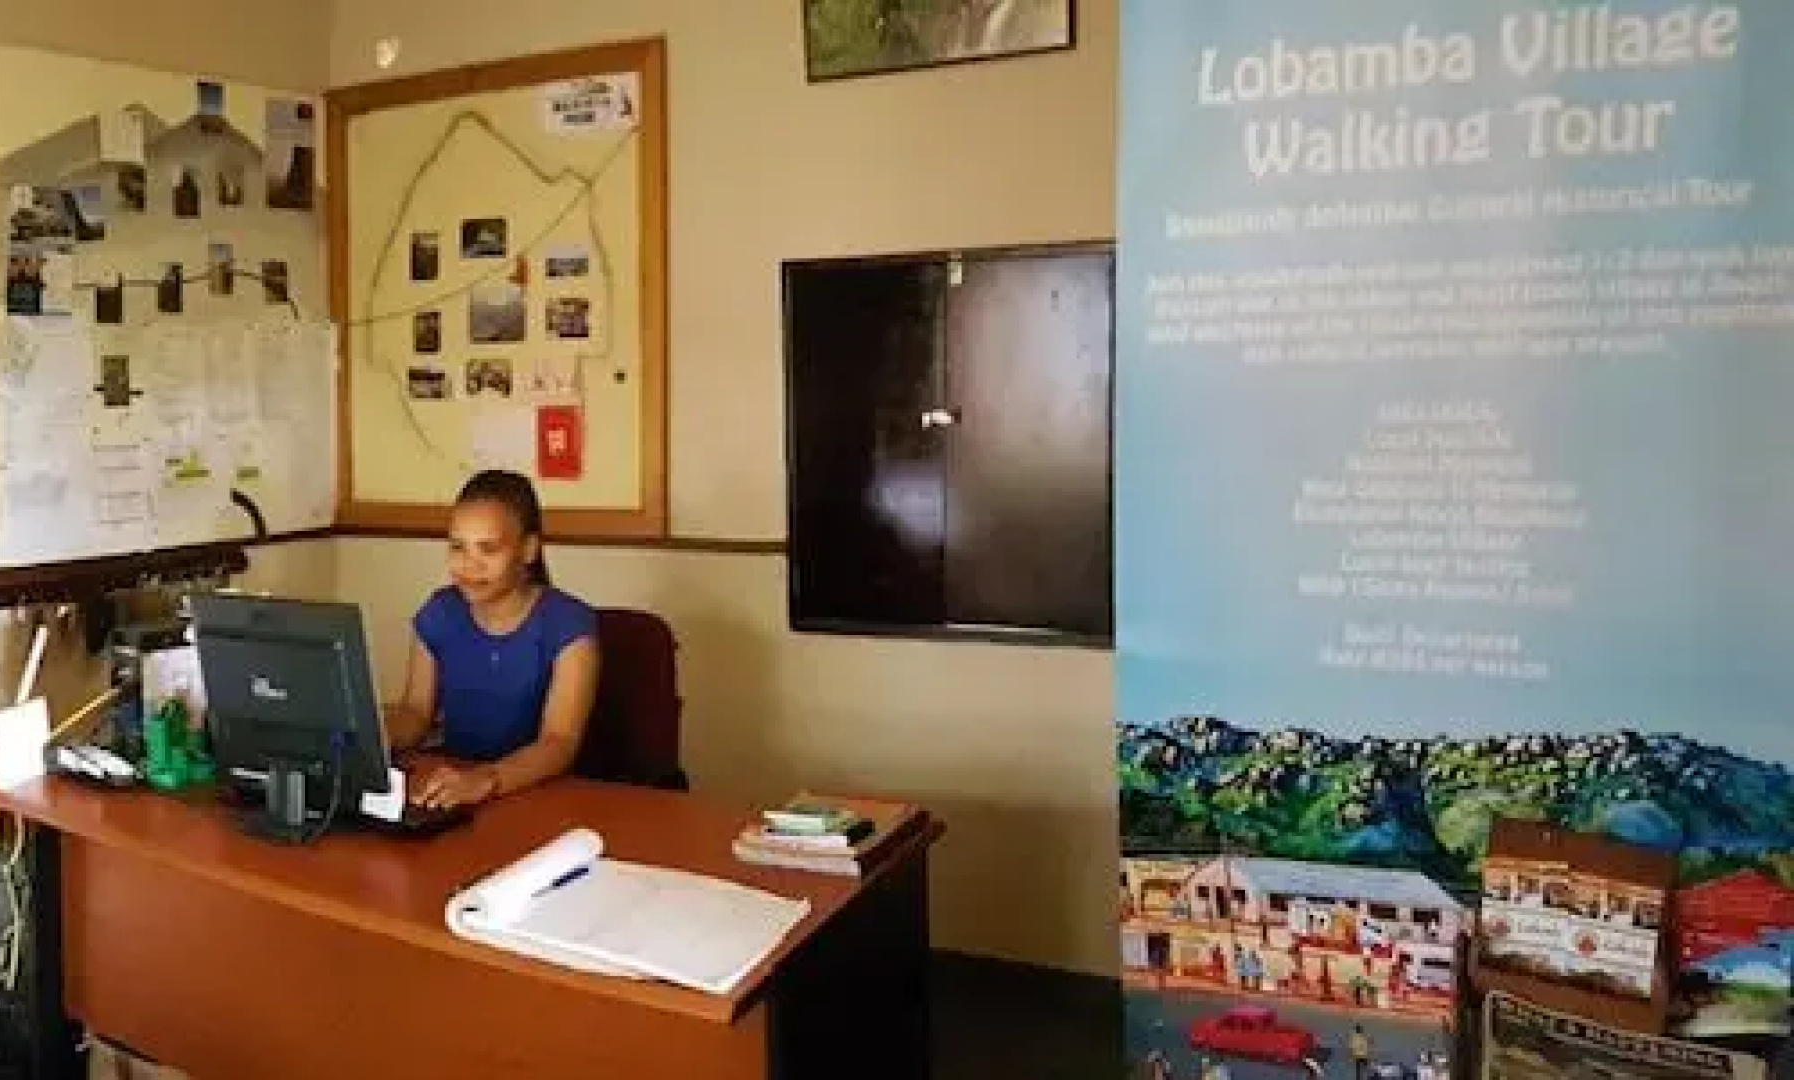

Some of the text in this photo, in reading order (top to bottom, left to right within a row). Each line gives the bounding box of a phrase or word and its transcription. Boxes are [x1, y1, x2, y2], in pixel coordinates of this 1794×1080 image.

[1197, 4, 1740, 105] Lobamba Village
[1244, 96, 1676, 180] Walking Tour
[1684, 178, 1756, 206] Tour
